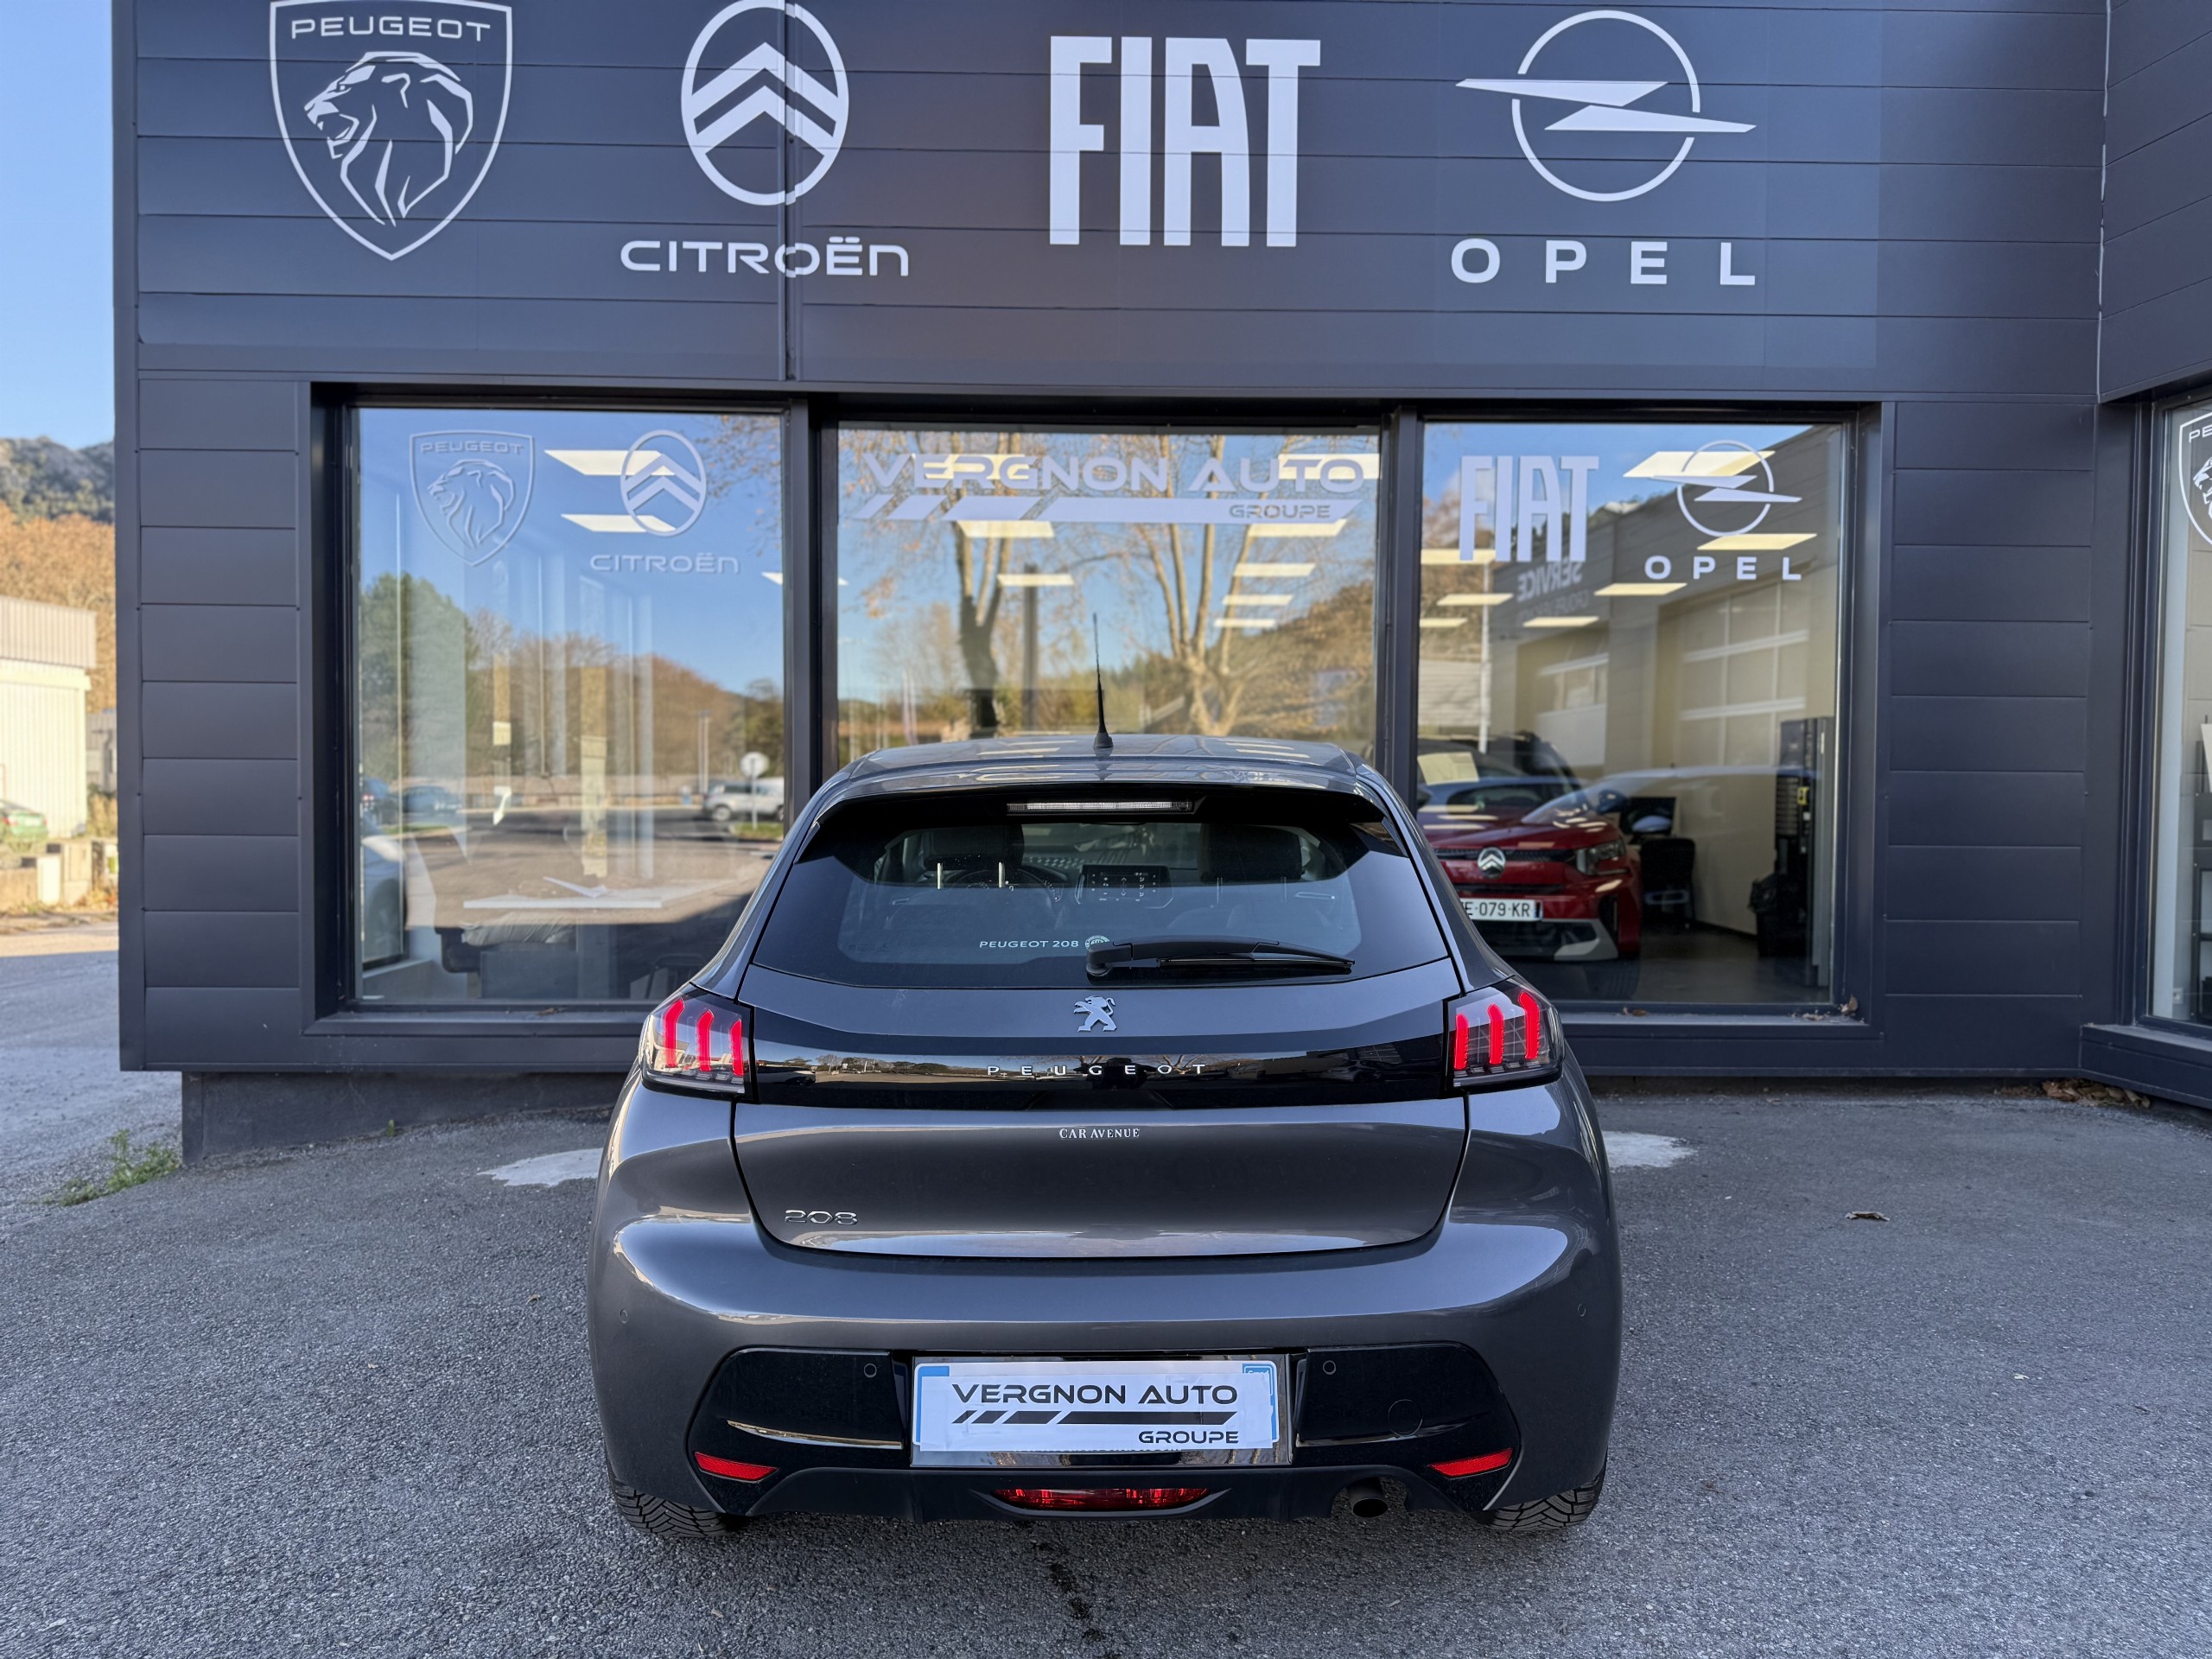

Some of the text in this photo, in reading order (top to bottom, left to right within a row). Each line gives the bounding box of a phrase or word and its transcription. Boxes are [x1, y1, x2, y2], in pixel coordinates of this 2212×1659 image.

[291, 16, 491, 41] PEUGEOT
[1049, 35, 1321, 248] FIAT
[1451, 238, 1756, 286] OPEL
[419, 440, 524, 454] PEUGEOT
[864, 452, 1365, 494] VERGNON AUTO
[1229, 504, 1332, 518] GROUPE
[1459, 454, 1599, 563] FIAT
[1644, 555, 1802, 581] OPEL
[1461, 901, 1530, 918] E-079-KR
[979, 940, 1049, 949] PEUGEOT
[1052, 939, 1079, 948] 208
[987, 1064, 1206, 1077] PEUGEOT
[1058, 1127, 1141, 1140] CAR AVENUE
[785, 1209, 858, 1226] 208
[951, 1383, 1238, 1406] VERGNON AUTO
[1138, 1430, 1239, 1445] GROUPE
